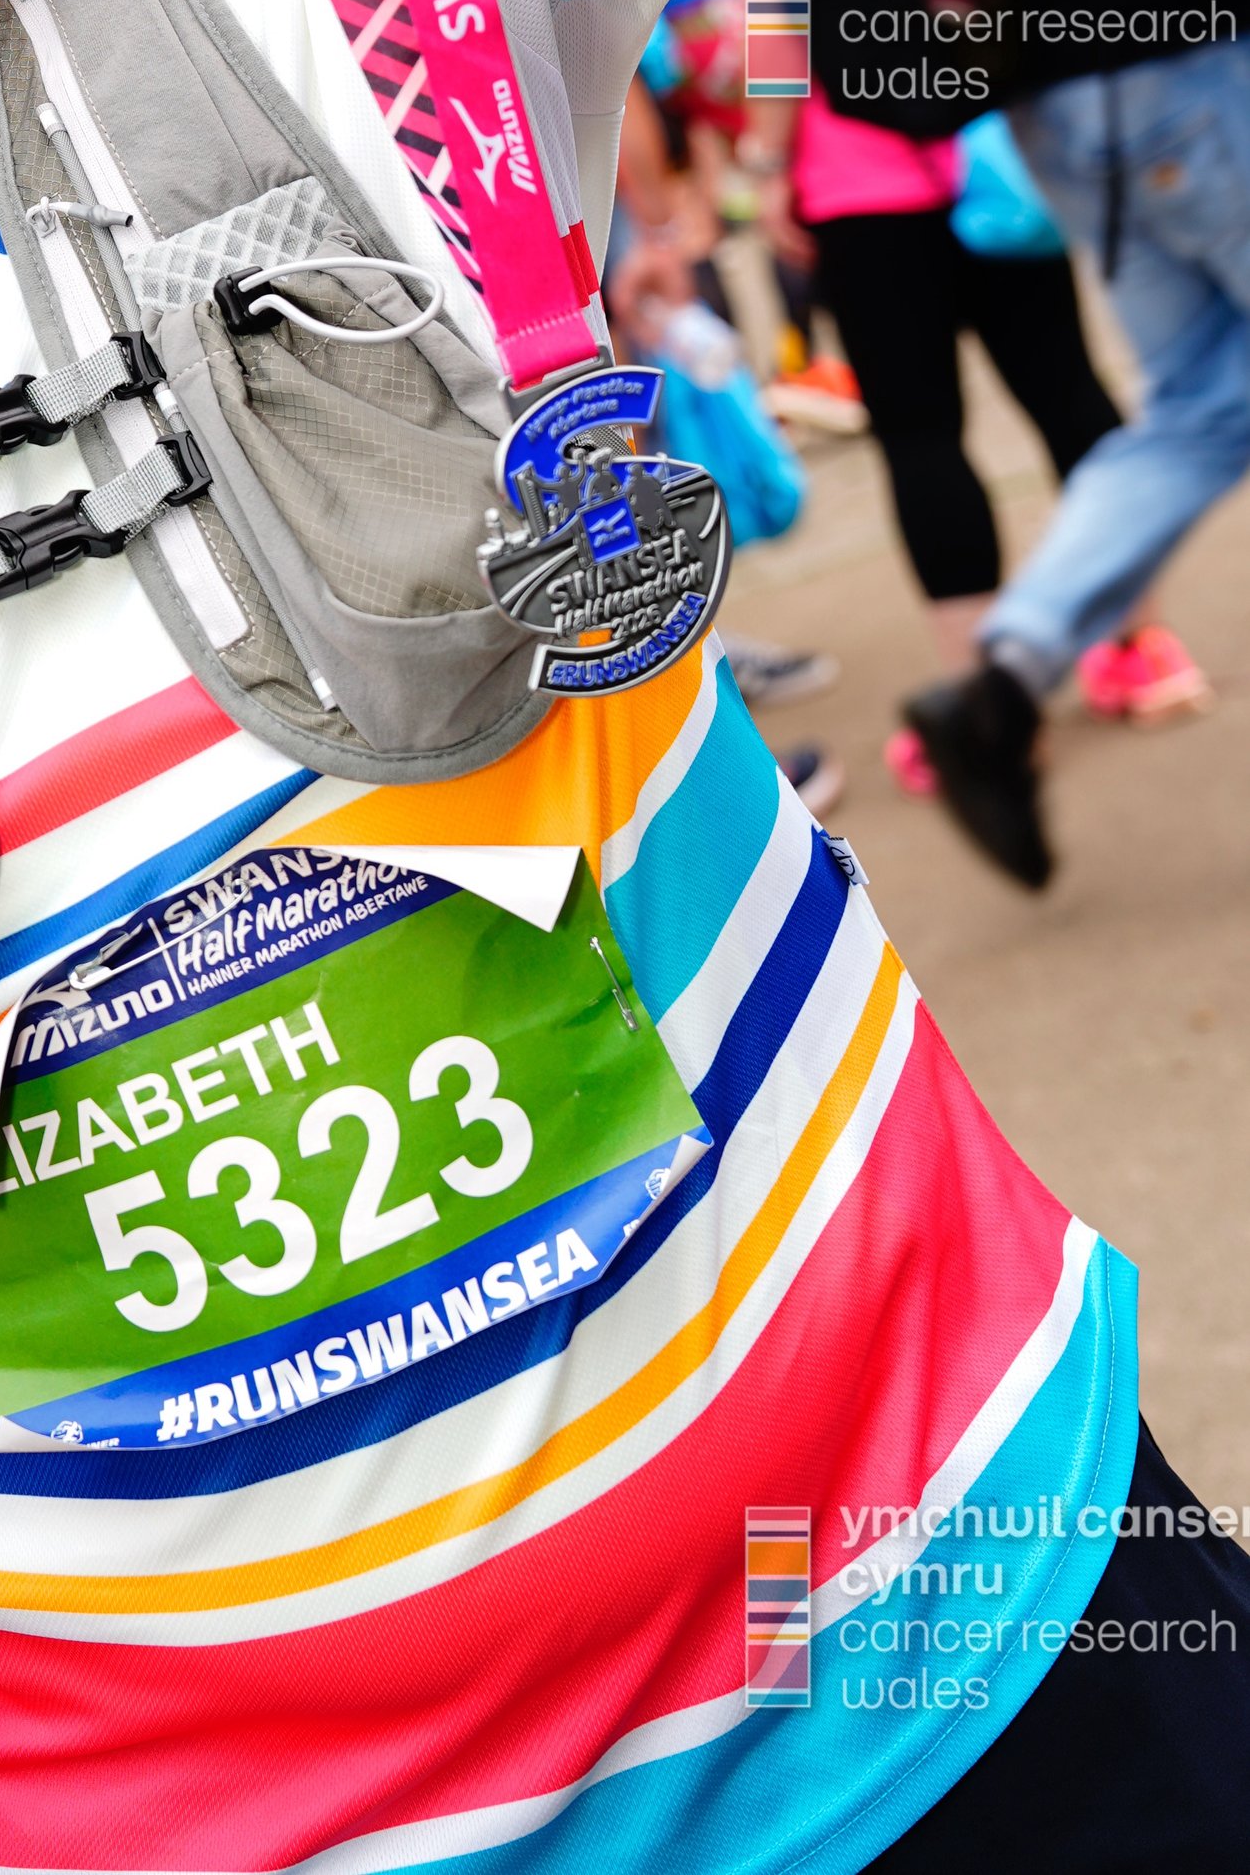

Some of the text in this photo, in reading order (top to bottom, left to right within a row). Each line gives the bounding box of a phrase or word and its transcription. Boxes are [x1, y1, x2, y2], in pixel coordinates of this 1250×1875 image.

[164, 847, 347, 934] SWANS
[177, 911, 254, 975] Half
[187, 874, 429, 996] HANNER MARATHON ABERTAWE
[84, 1035, 535, 1334] 5323
[156, 1228, 600, 1442] #RUNSWANSEA
